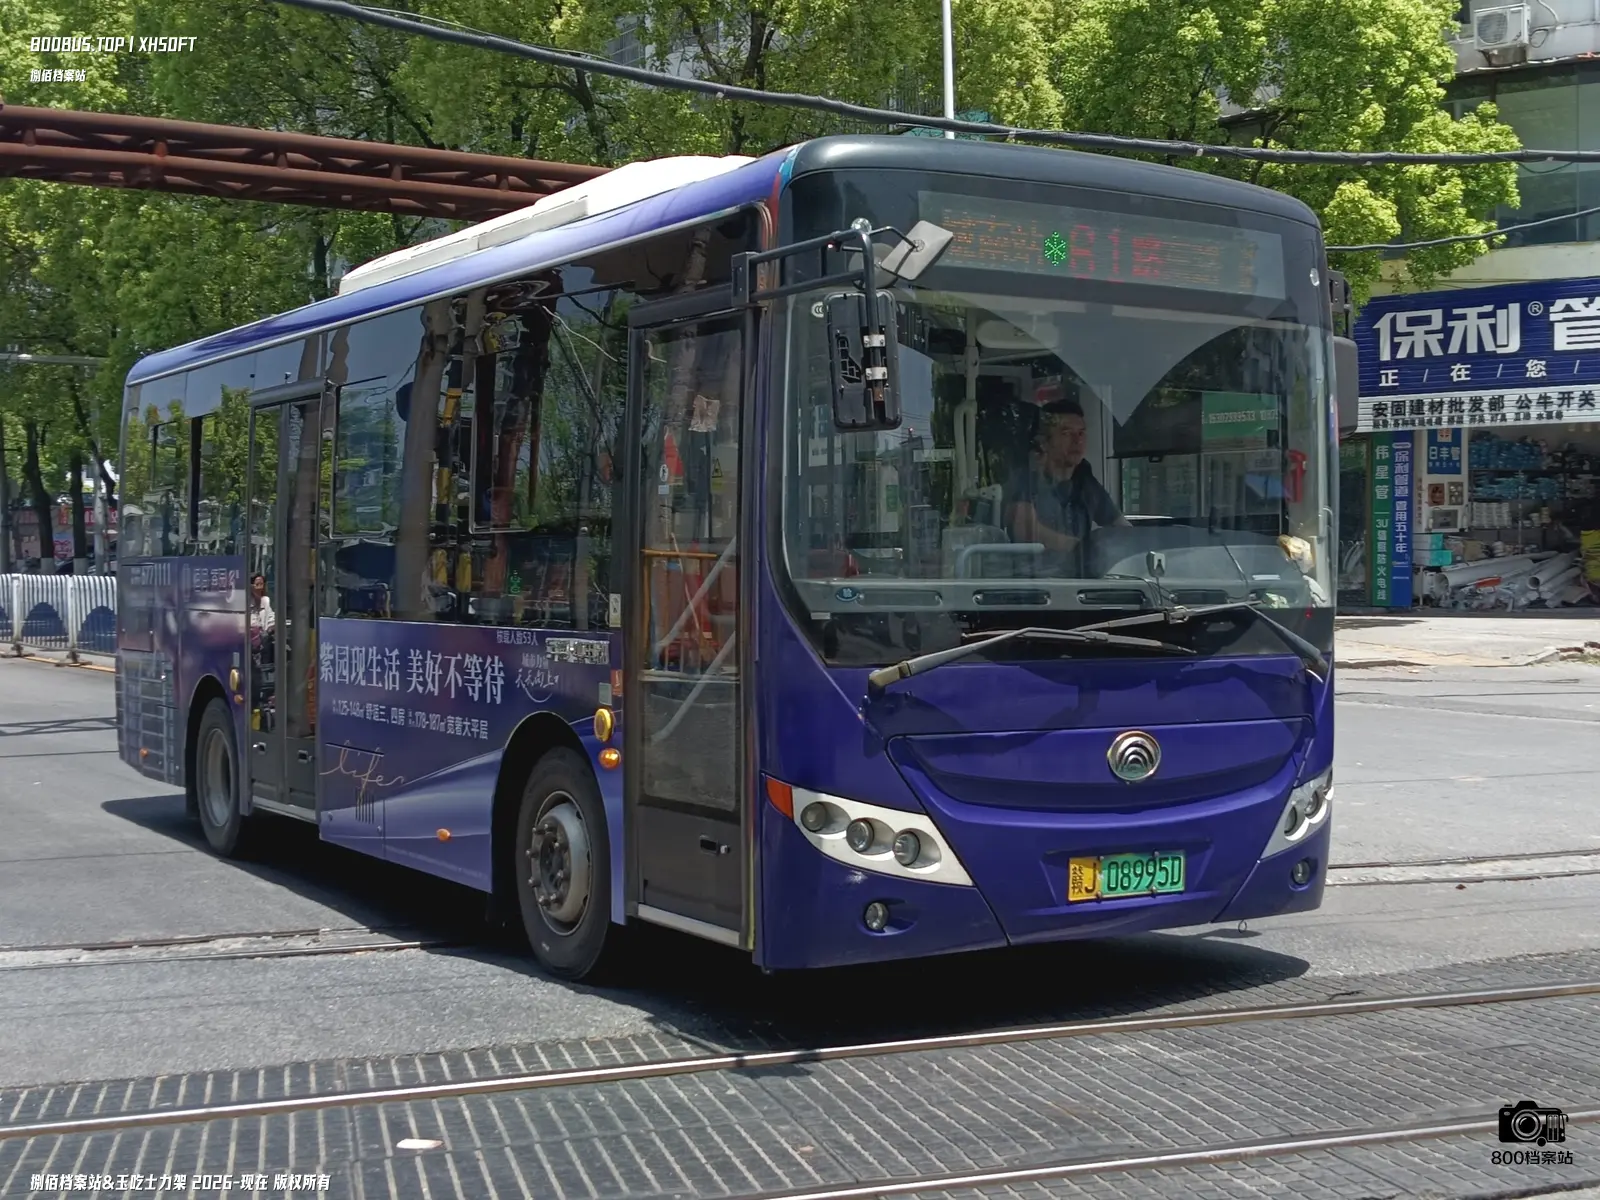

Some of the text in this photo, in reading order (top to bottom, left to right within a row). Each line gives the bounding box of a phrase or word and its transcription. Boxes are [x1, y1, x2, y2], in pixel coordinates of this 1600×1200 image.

[1515, 391, 1596, 411] 公牛开关
[319, 642, 400, 691] 紫园现生活
[407, 649, 505, 705] 美好不等待
